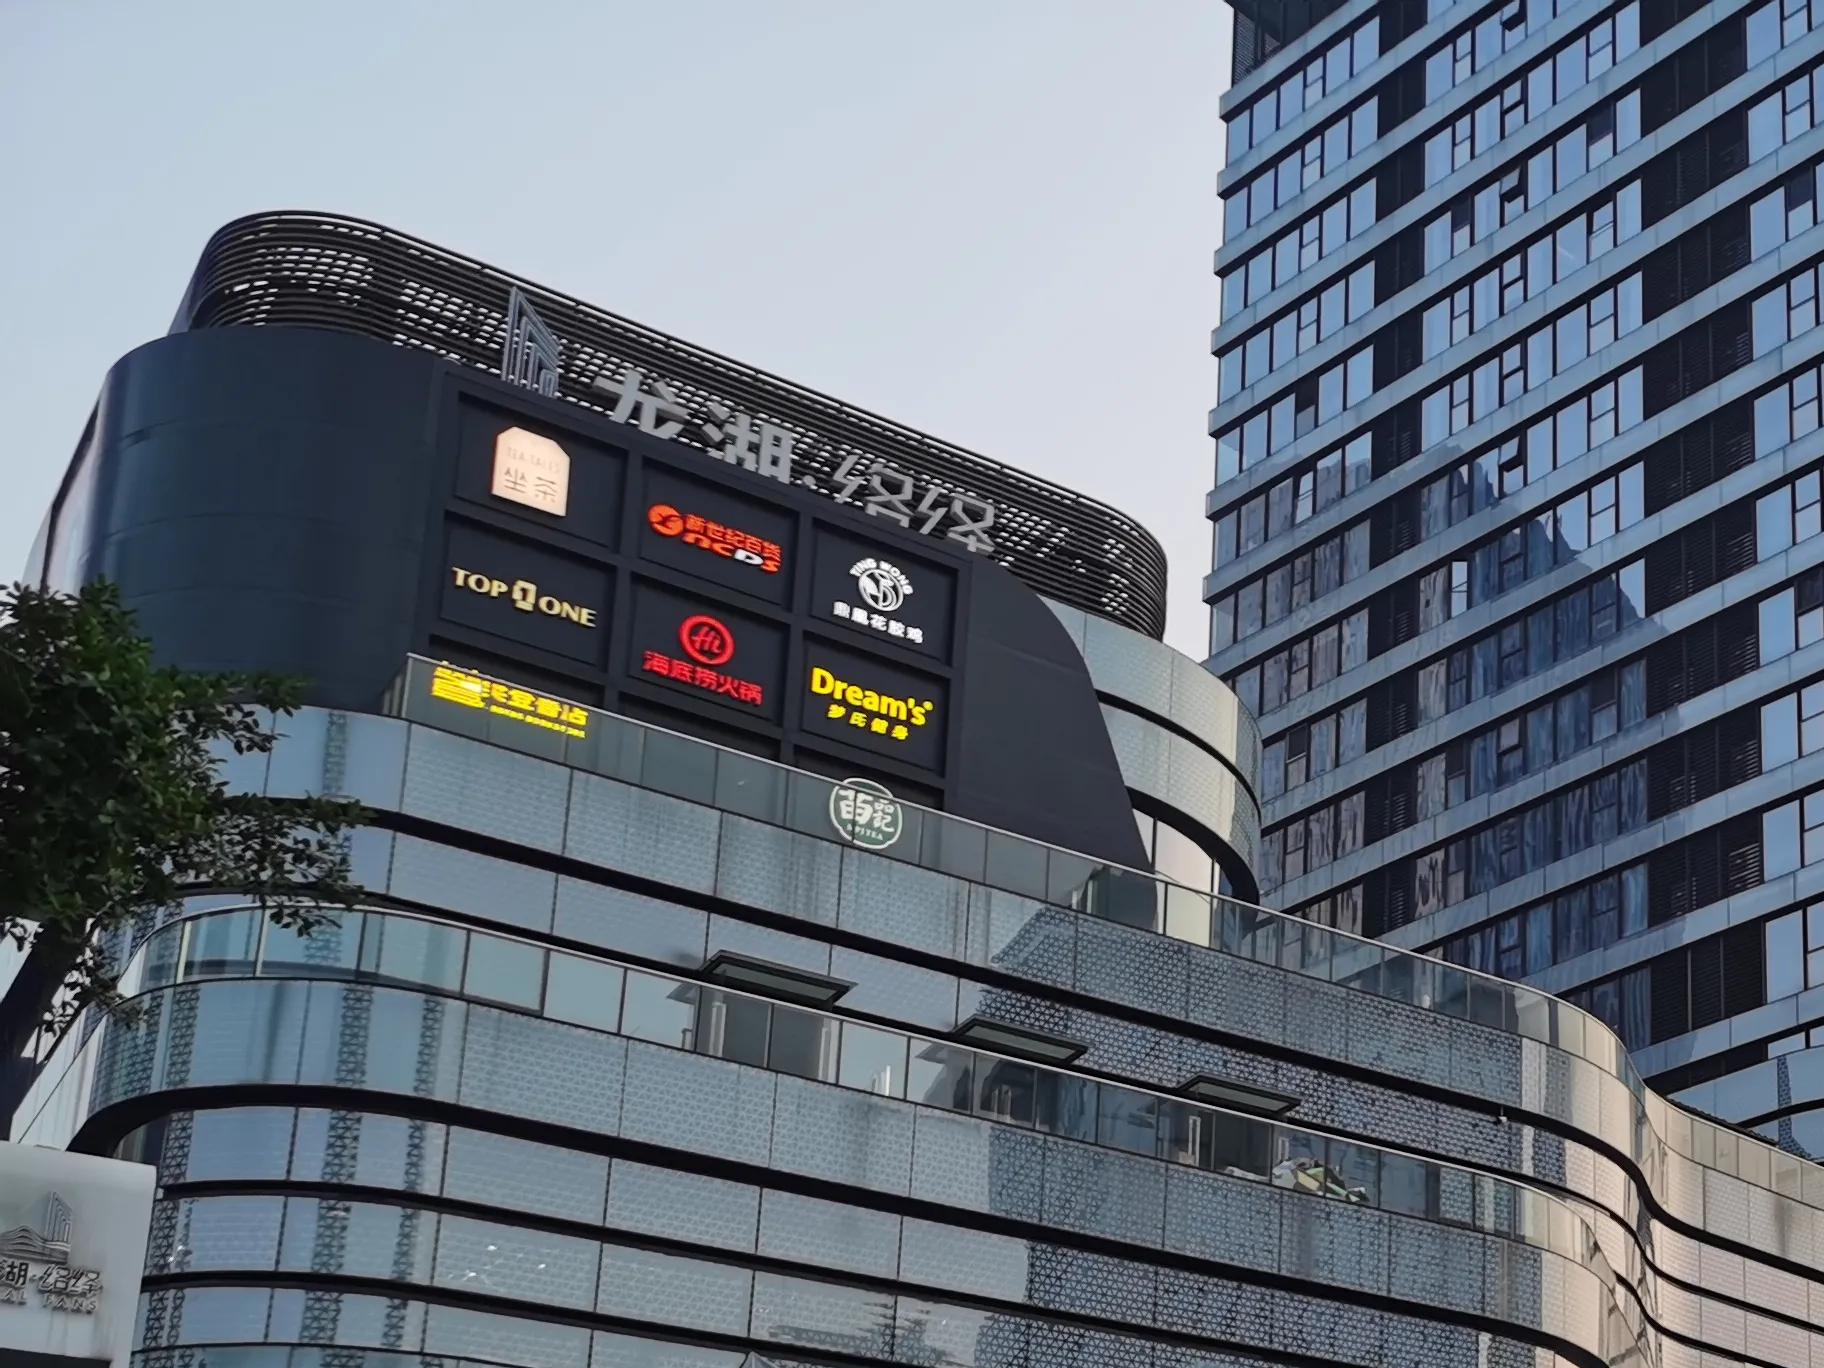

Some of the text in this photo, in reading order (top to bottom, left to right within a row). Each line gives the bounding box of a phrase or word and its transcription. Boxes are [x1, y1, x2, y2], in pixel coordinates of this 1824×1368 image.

[451, 566, 509, 597] TOP
[538, 596, 598, 628] ONE
[810, 666, 927, 726] Dream's
